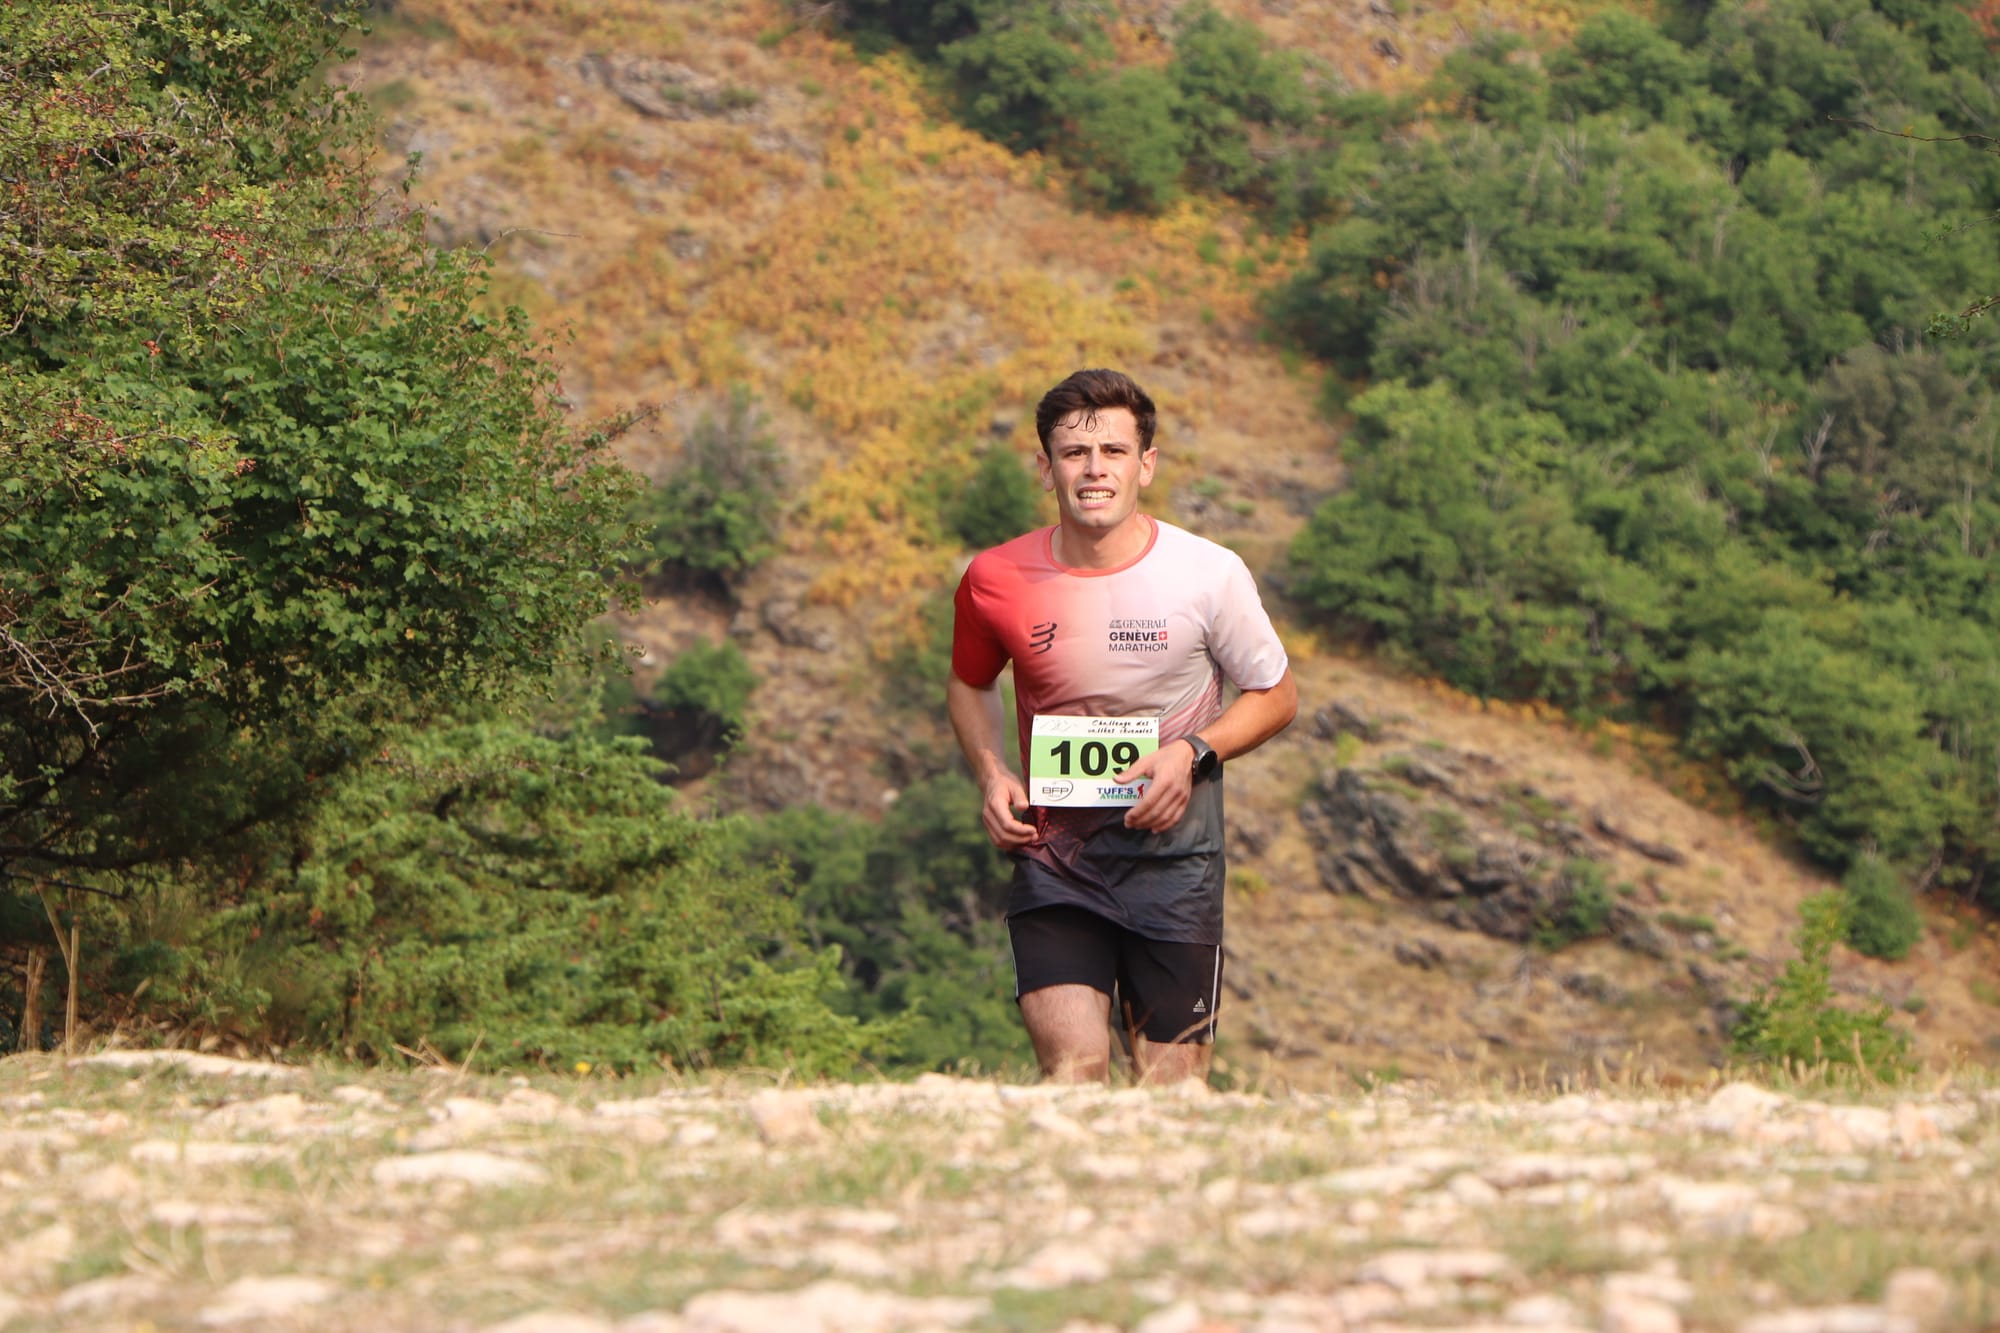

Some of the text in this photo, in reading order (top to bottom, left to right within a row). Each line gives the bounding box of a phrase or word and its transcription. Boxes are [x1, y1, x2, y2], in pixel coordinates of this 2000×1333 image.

[1122, 619, 1167, 629] GENERALI
[1109, 629, 1158, 641] GENÈVE
[1109, 642, 1168, 652] MARATHON
[1050, 740, 1140, 776] 109
